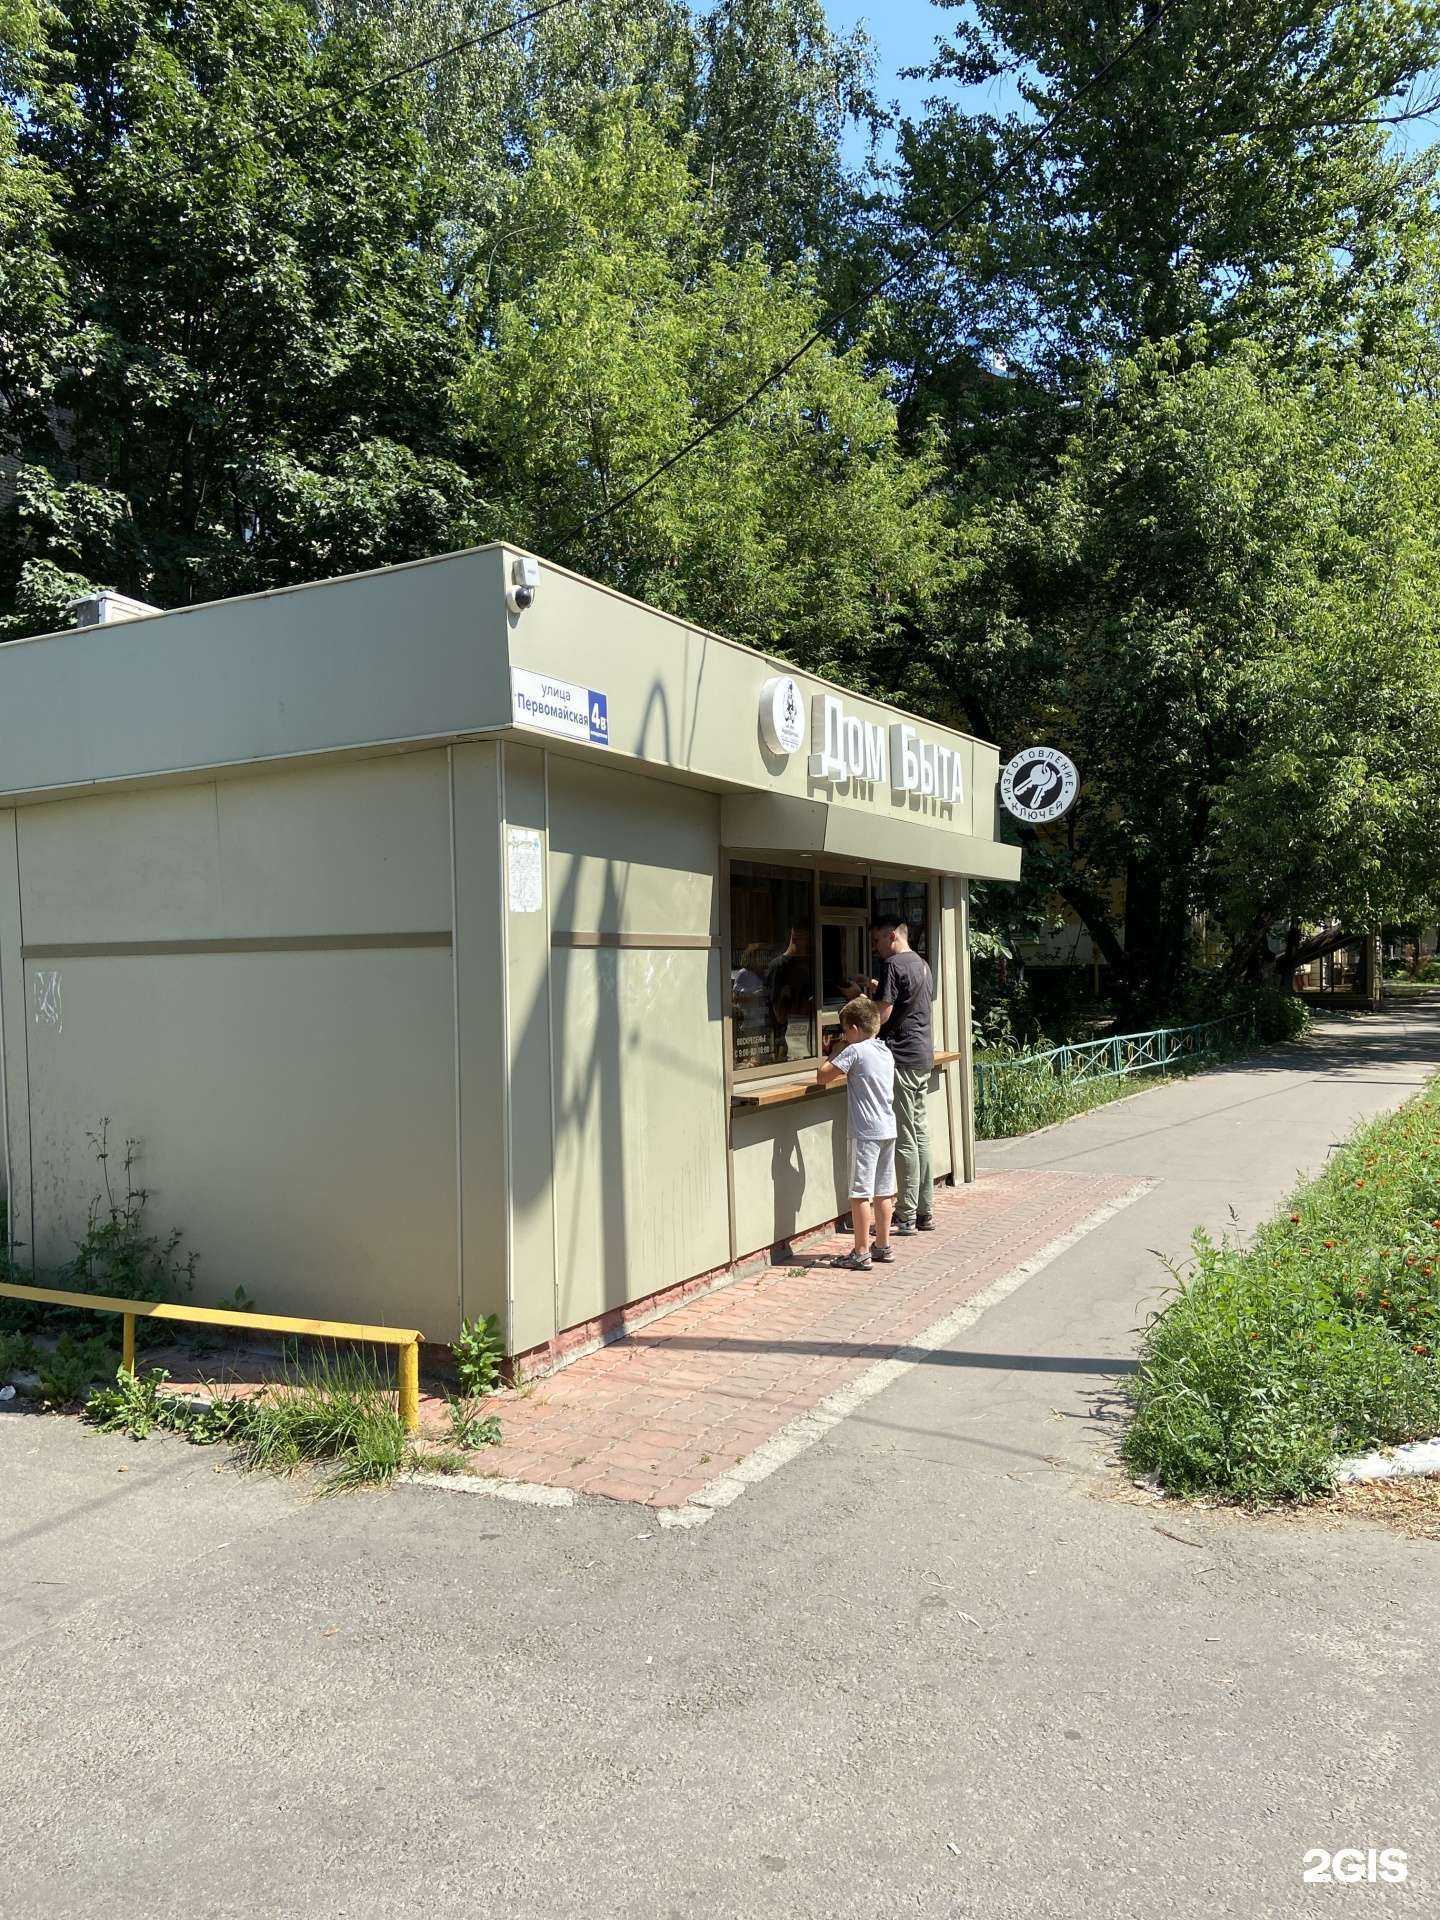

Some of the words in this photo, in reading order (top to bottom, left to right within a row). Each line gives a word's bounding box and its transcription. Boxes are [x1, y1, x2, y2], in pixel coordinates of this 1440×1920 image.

[541, 683, 571, 702] улица
[517, 692, 589, 727] Первомайская
[1003, 749, 1073, 794] ИЗГОТОВЛЕНИЕ
[1011, 800, 1063, 820] КЛЮЧЕЙ
